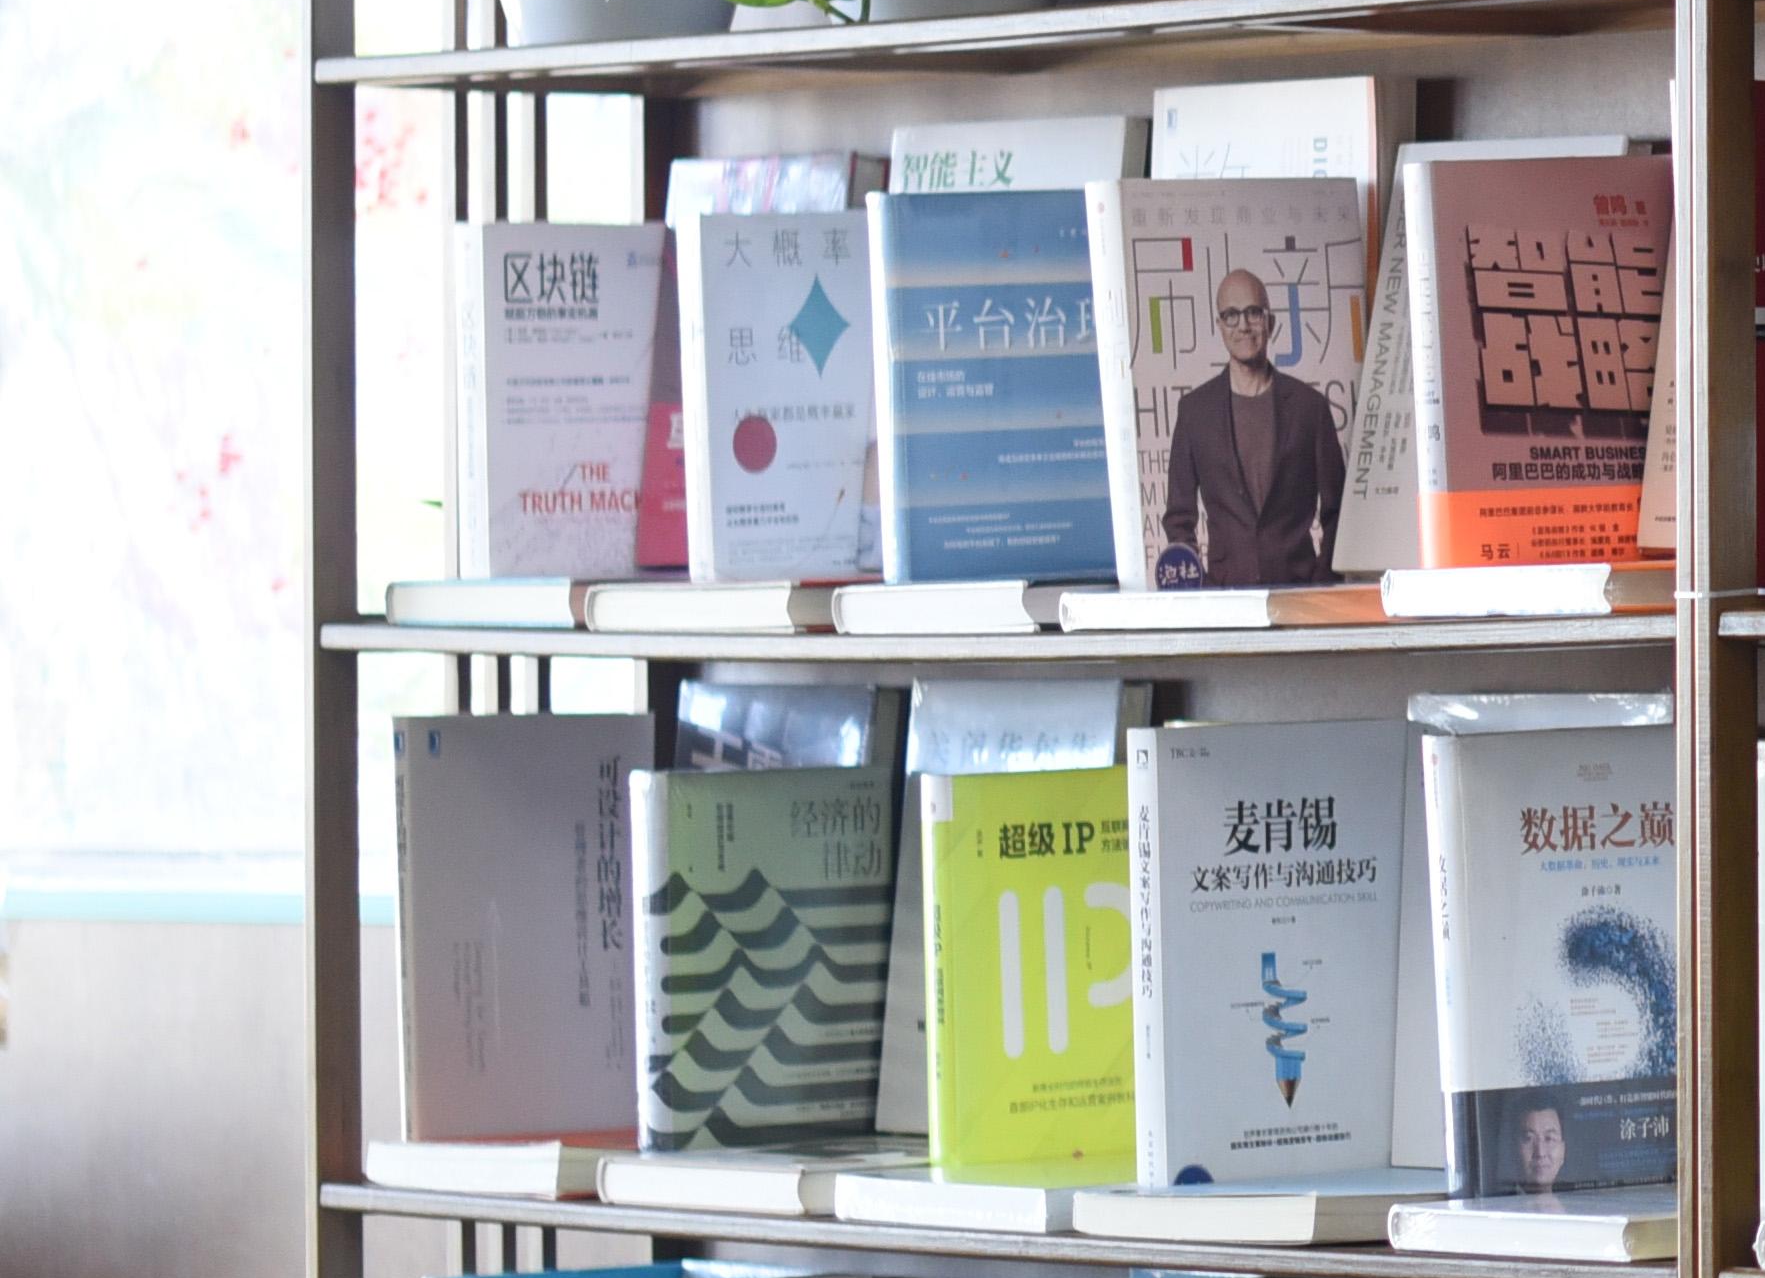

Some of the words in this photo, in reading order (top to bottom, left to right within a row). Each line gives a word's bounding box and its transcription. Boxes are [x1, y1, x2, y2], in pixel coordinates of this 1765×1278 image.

[901, 148, 1016, 191] 智能主义
[725, 228, 852, 268] 大概率
[504, 252, 598, 303] 区块链
[1352, 324, 1394, 500] MANAGEMENT
[579, 461, 612, 483] THE
[1530, 446, 1581, 461] SMART
[518, 490, 583, 516] TRUTH
[790, 798, 882, 839] 经济的
[1223, 794, 1338, 857] 麦肯锡
[1519, 800, 1676, 857] 数据之巅
[998, 822, 1056, 860] 超级
[1063, 820, 1096, 854] IP
[823, 842, 882, 880] 律动
[1191, 856, 1378, 894] 文案写作与沟通技巧
[1190, 894, 1252, 913] COPYWRITING
[1254, 895, 1274, 909] AND
[1619, 1115, 1670, 1141] 涂子沛
